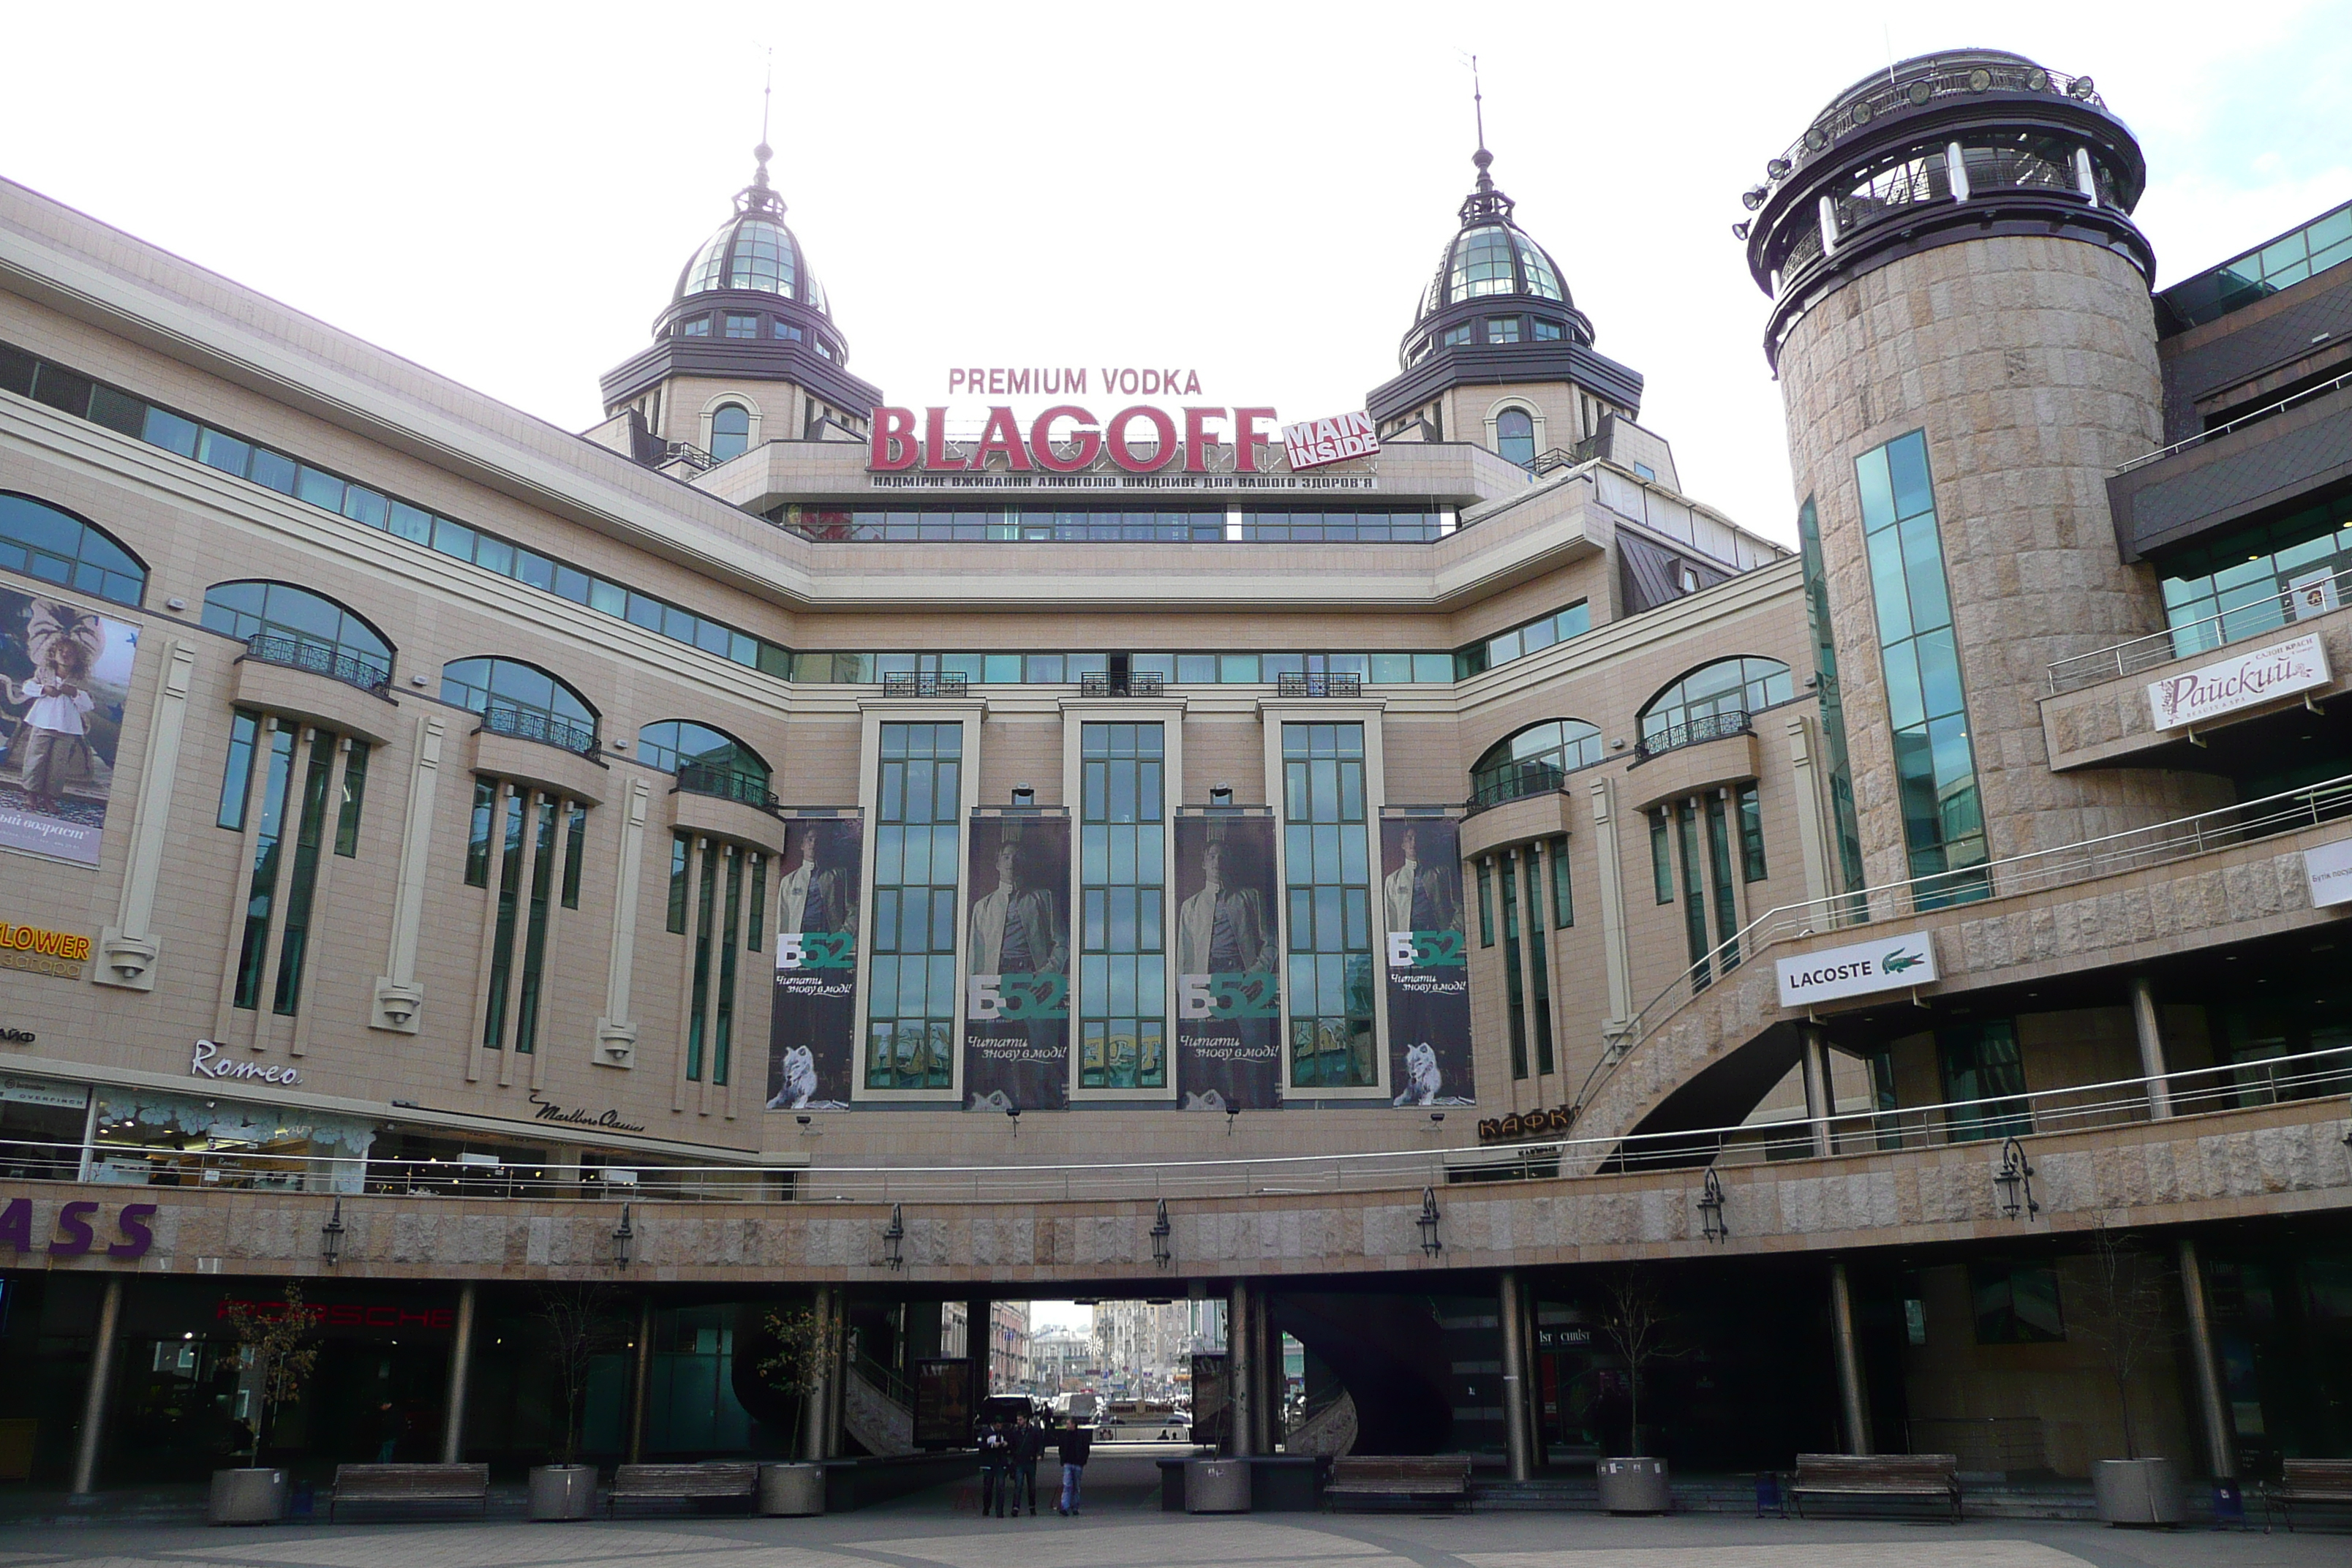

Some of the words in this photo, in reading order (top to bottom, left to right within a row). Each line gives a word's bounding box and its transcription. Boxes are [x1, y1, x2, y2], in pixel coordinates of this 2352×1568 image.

[949, 368, 1087, 394] PREMIUM
[1102, 368, 1202, 395] VODKA
[864, 404, 1278, 472] BLAGOFF
[1283, 411, 1373, 450] MAIN
[1289, 432, 1379, 468] INSIDE
[873, 477, 946, 488] НАДМІРНЕ
[951, 477, 1032, 488] ВЖИВАННЯ
[1038, 477, 1116, 488] АЛКОГОЛЮ
[1123, 477, 1196, 488] ШКІДЛИВЕ
[1204, 478, 1233, 489] ДЛЯ
[1238, 478, 1296, 489] ВАШОГО
[2171, 657, 2293, 714] Райский
[4, 953, 80, 978] загара
[1391, 973, 1436, 983] Читати
[1790, 961, 1872, 989] LACOSTE
[777, 976, 822, 985] Читати
[786, 985, 815, 995] знову
[823, 984, 852, 993] моді!
[1402, 984, 1431, 993] знову
[1439, 981, 1466, 991] моді!
[968, 1036, 1028, 1047] Читати
[1180, 1035, 1240, 1047] Читати
[1195, 1047, 1232, 1060] знову
[1243, 1044, 1279, 1058] моді!
[982, 1049, 1019, 1061] знову
[1030, 1047, 1066, 1058] моді!
[529, 1095, 598, 1125] Marlboro
[599, 1109, 646, 1132] Classics
[1478, 1107, 1580, 1138] КАФК
[0, 1198, 157, 1256] ASS
